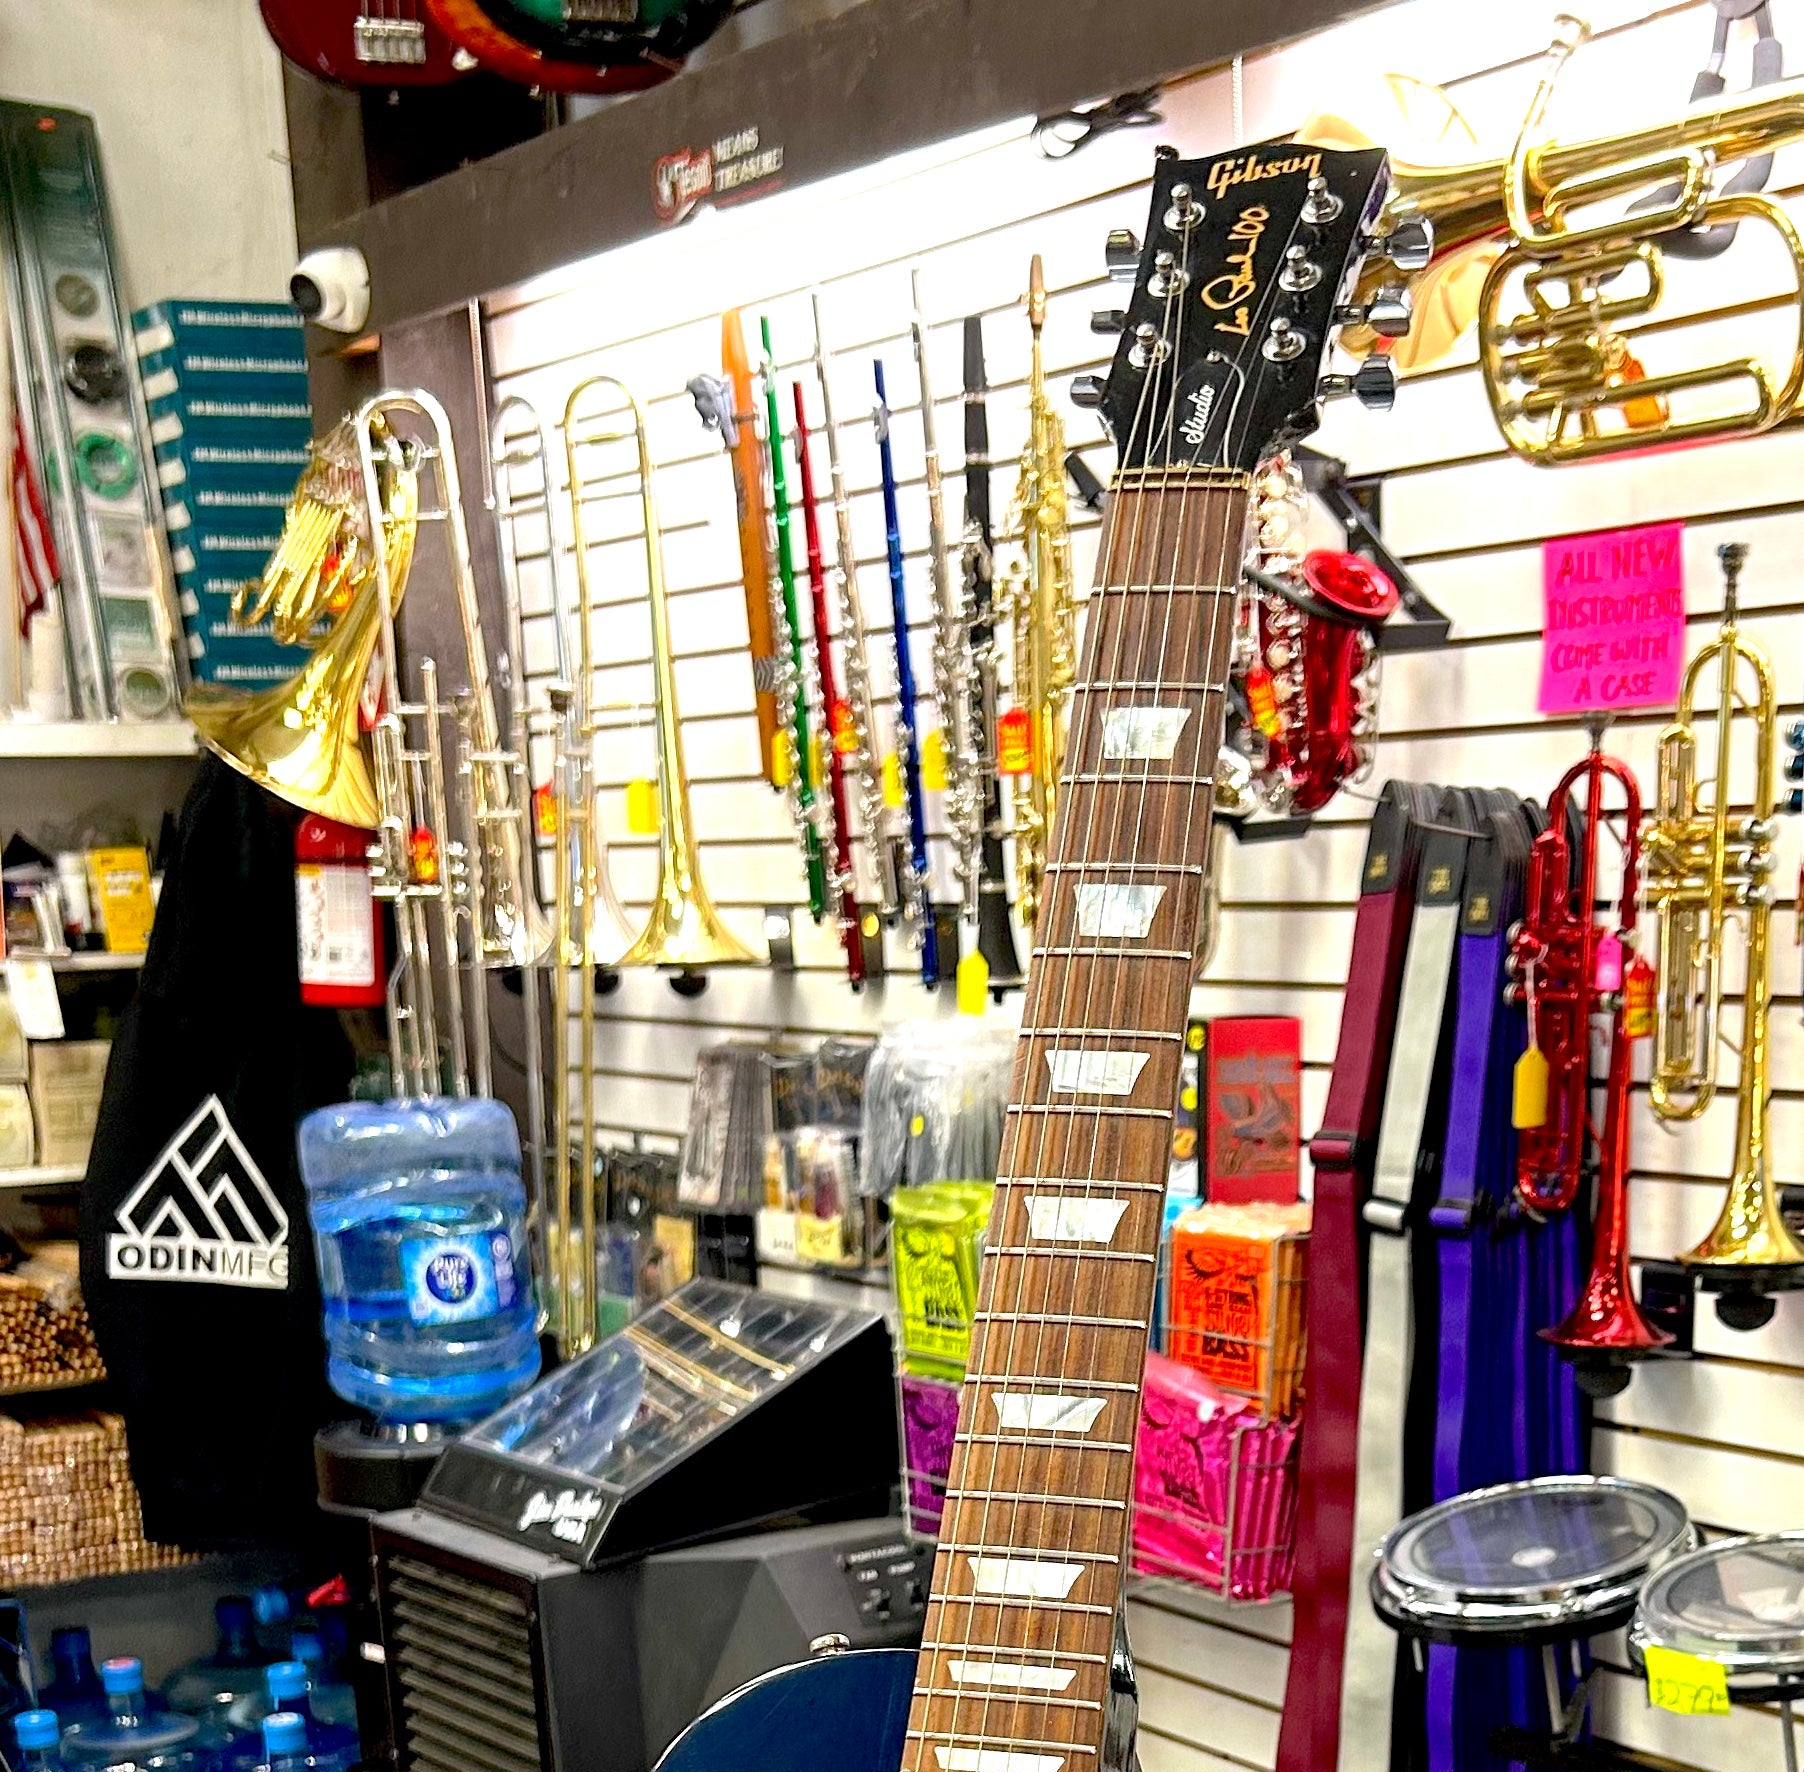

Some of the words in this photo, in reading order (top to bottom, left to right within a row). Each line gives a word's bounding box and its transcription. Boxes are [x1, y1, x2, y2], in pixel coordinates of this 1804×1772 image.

[1206, 153, 1323, 200] Gibson
[1179, 384, 1215, 445] Studio
[1555, 551, 1602, 586] ALL
[1611, 538, 1678, 582] NEW
[1551, 642, 1605, 673] COME
[1609, 632, 1669, 662] WITH
[1573, 676, 1592, 703] A
[1601, 671, 1657, 702] CASE
